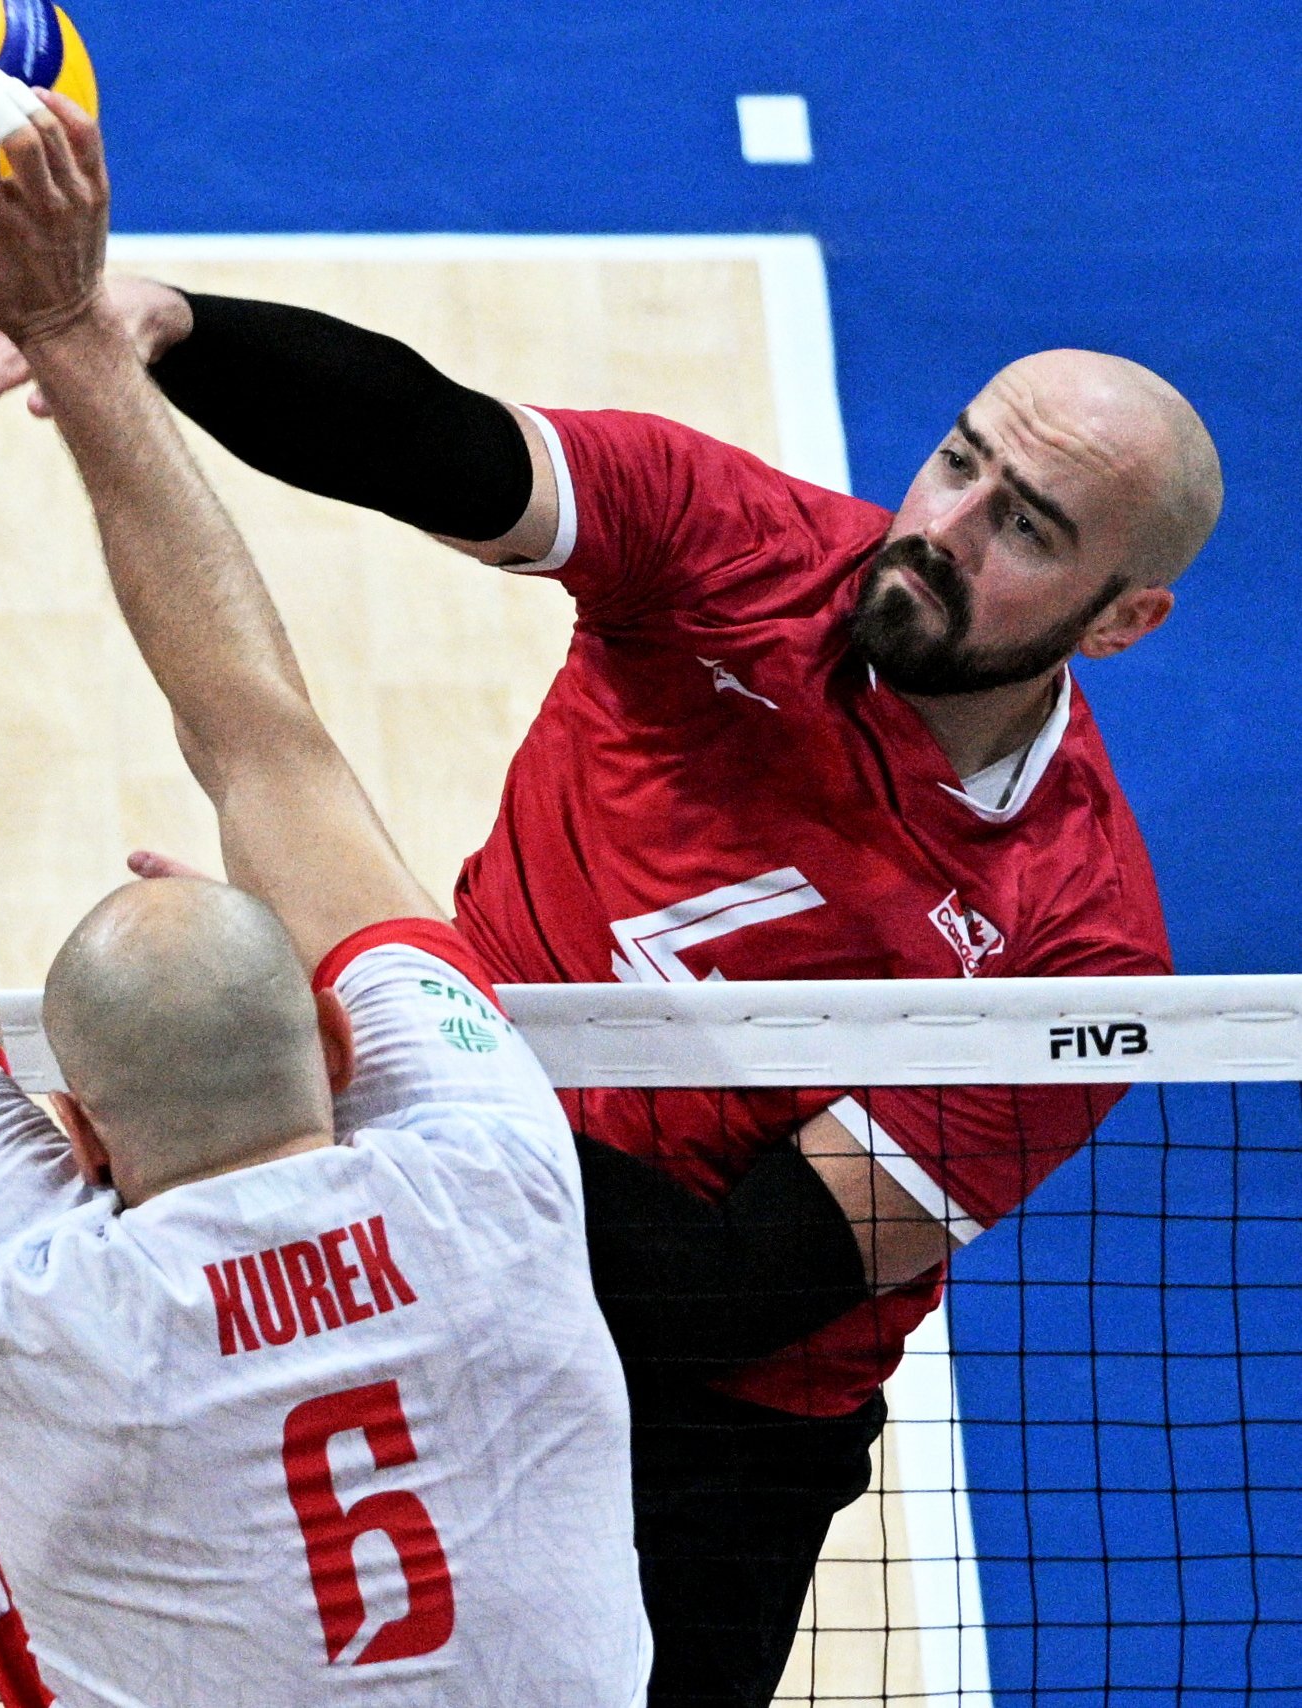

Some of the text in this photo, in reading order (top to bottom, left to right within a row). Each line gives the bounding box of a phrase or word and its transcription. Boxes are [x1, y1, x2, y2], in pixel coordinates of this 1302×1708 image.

[1049, 1023, 1149, 1059] FIVB
[203, 1215, 418, 1356] KUREK
[282, 1379, 455, 1665] 6
